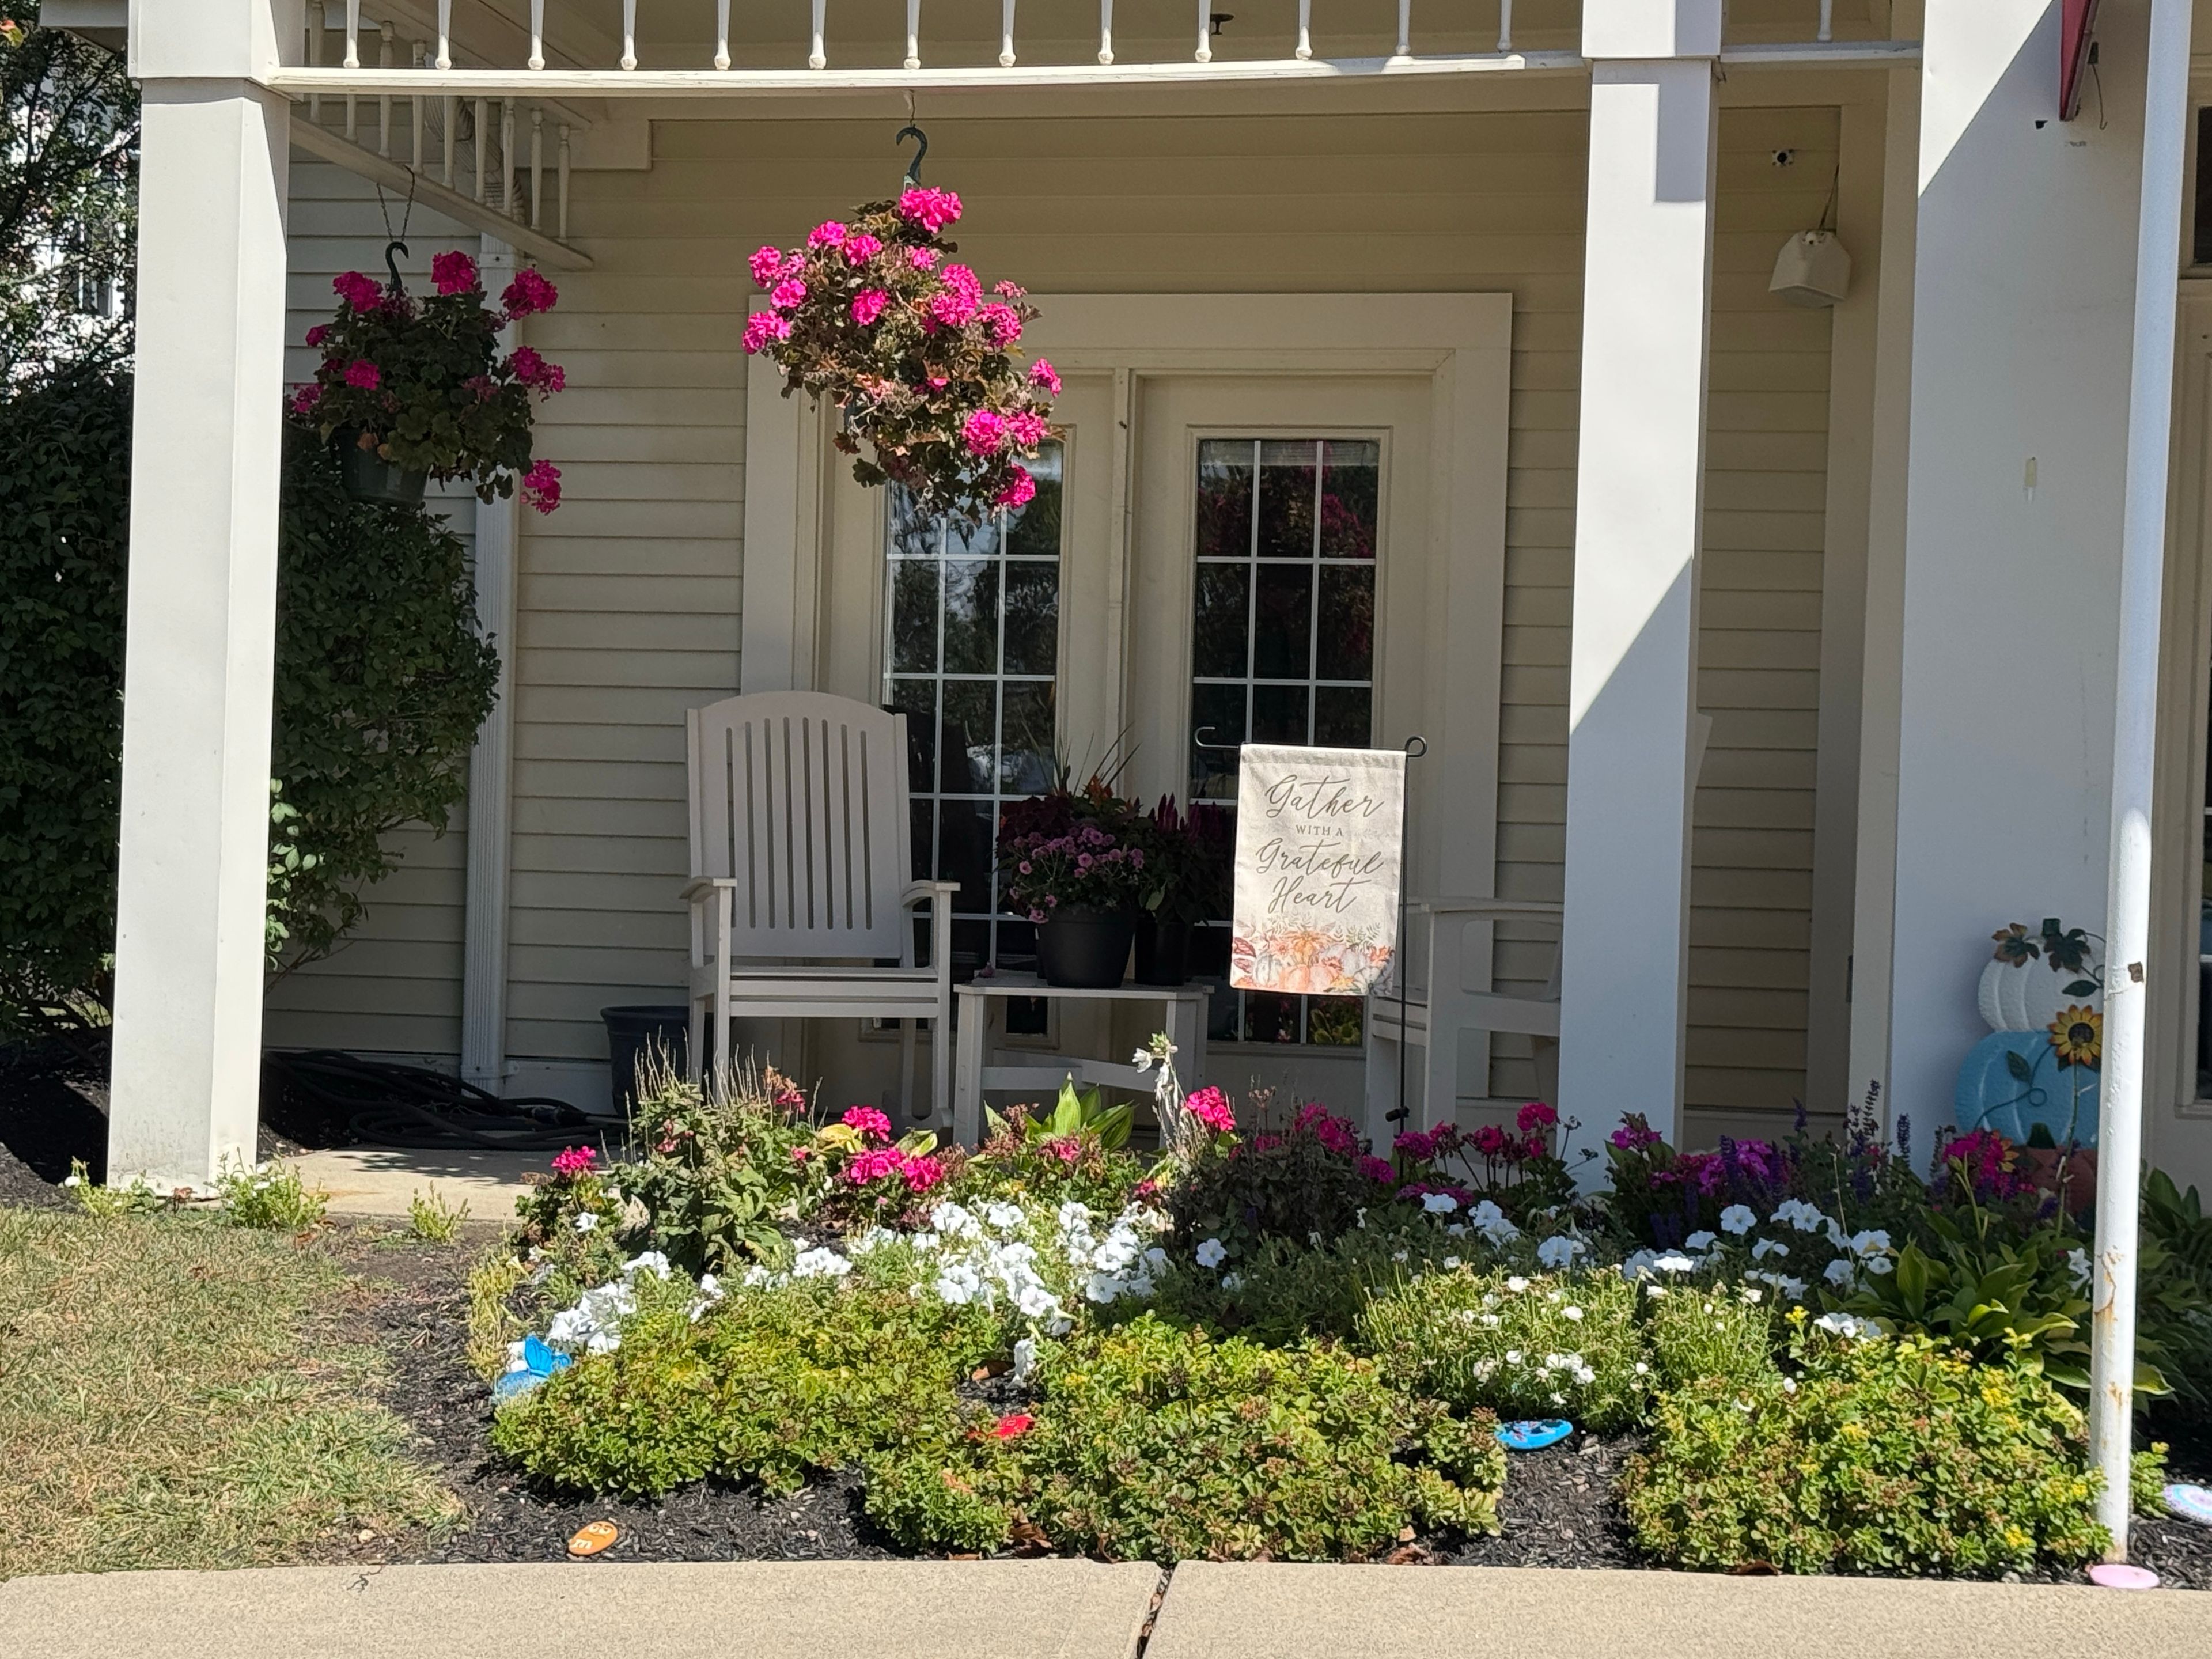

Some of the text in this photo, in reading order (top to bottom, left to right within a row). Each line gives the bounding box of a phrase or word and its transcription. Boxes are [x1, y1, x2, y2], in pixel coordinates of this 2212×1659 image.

[1264, 774, 1385, 819] Gather
[1295, 824, 1344, 837] WITH A
[1255, 837, 1384, 879] Grateful
[1267, 875, 1372, 914] Heart
